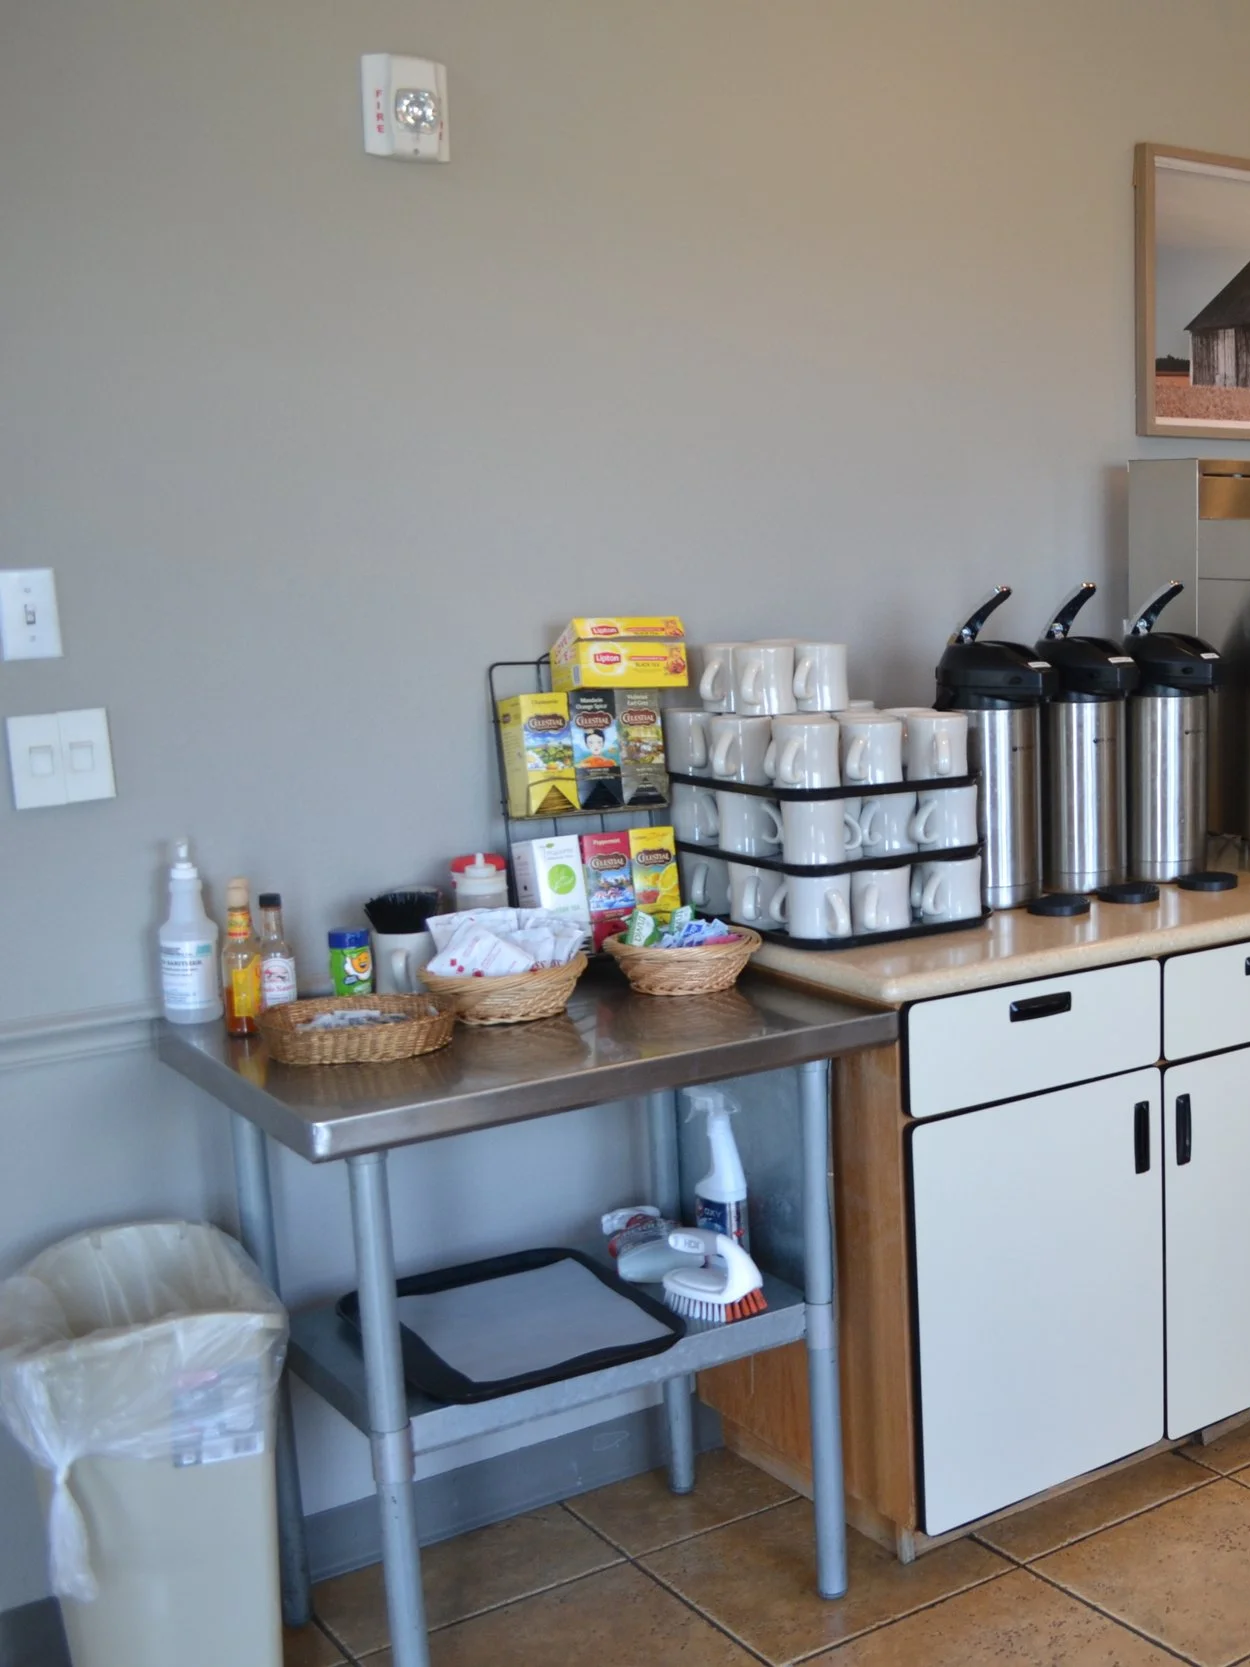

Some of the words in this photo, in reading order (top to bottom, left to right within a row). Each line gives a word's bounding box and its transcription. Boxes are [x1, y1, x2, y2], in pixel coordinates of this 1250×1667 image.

[376, 89, 384, 133] FIRE
[593, 626, 618, 635] Lipton
[595, 653, 620, 663] Lipton
[575, 714, 609, 725] CELESTIAL
[621, 711, 655, 722] CELESTIAL
[528, 718, 563, 728] CELESTIAL
[591, 858, 625, 868] CELESTIAL
[637, 853, 670, 863] CELESTIAL
